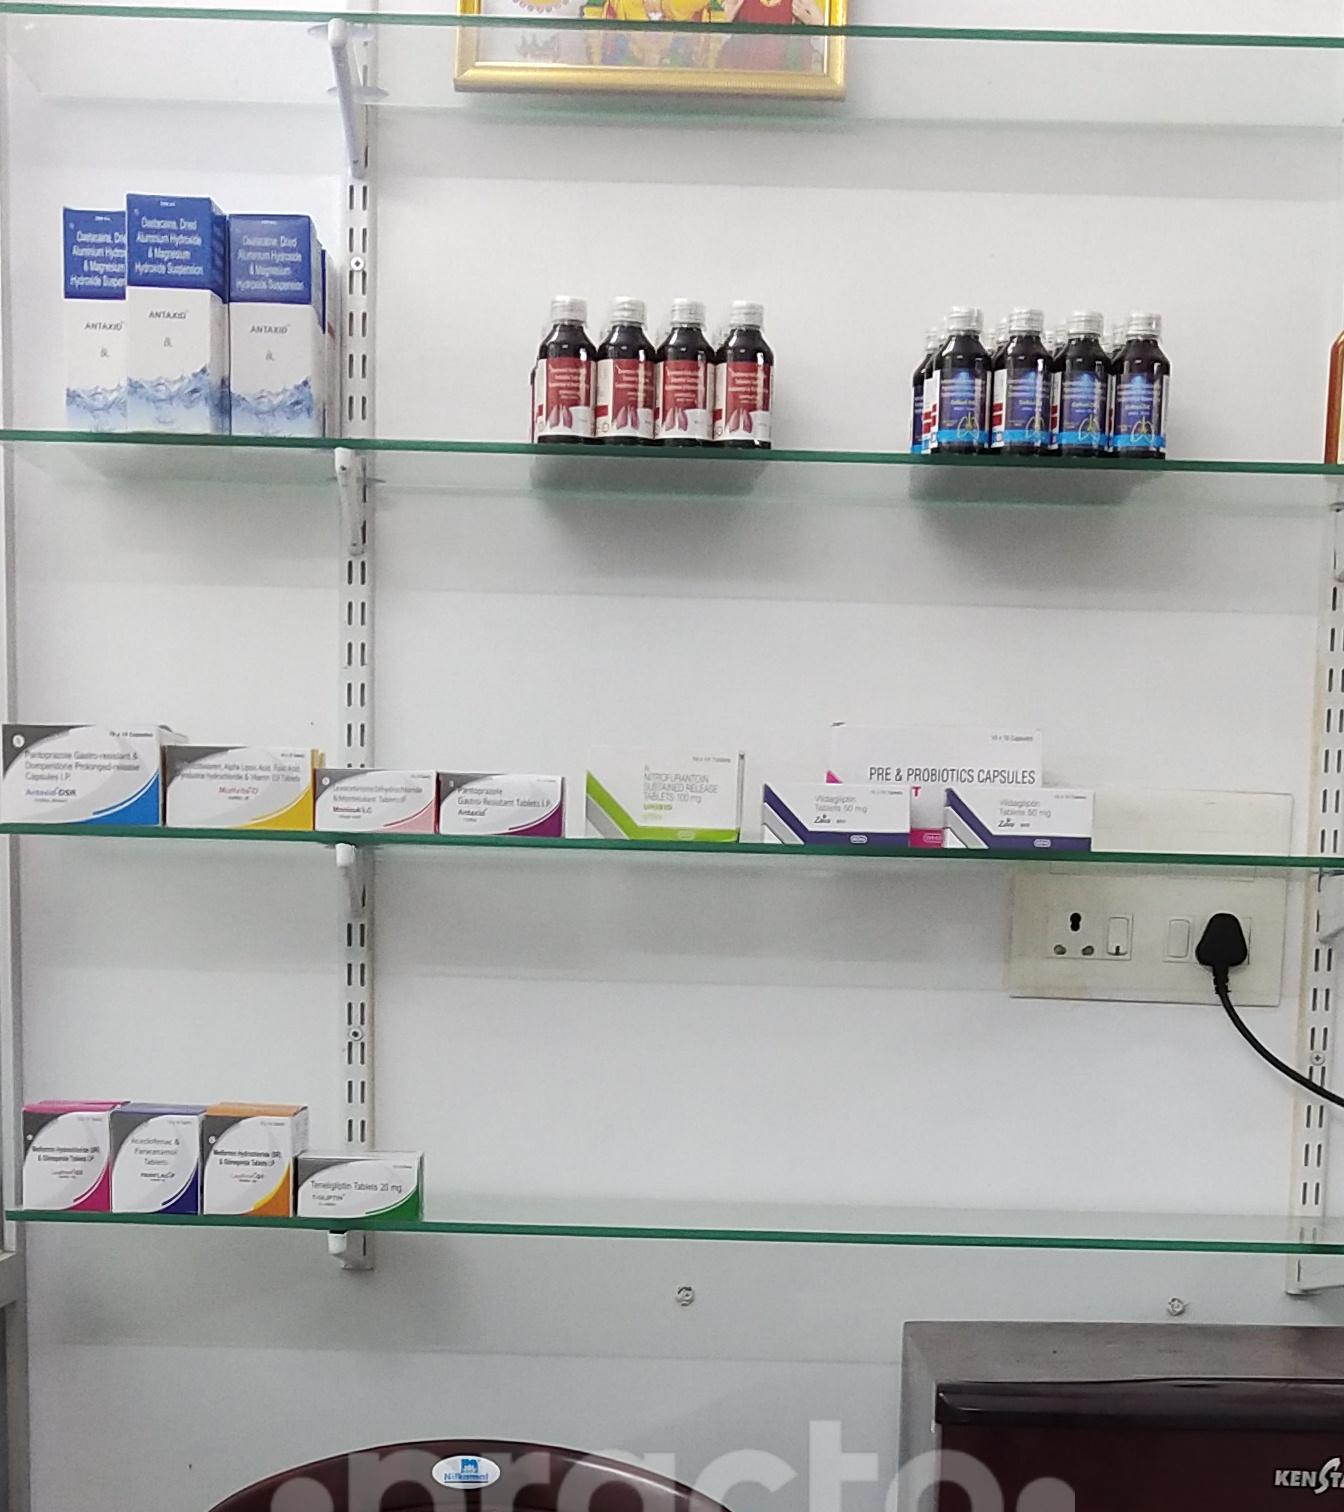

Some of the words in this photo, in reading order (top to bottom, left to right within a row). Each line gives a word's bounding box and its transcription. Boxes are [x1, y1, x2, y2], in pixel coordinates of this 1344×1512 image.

[869, 767, 892, 782] PRE
[895, 768, 903, 782] &
[907, 767, 975, 783] PROBIOTICS
[977, 768, 1036, 785] CAPSULES
[685, 784, 719, 794] RELEASE
[855, 805, 868, 814] mg
[1039, 810, 1052, 819] mg
[354, 1181, 378, 1191] Tablets
[390, 1184, 403, 1193] mg
